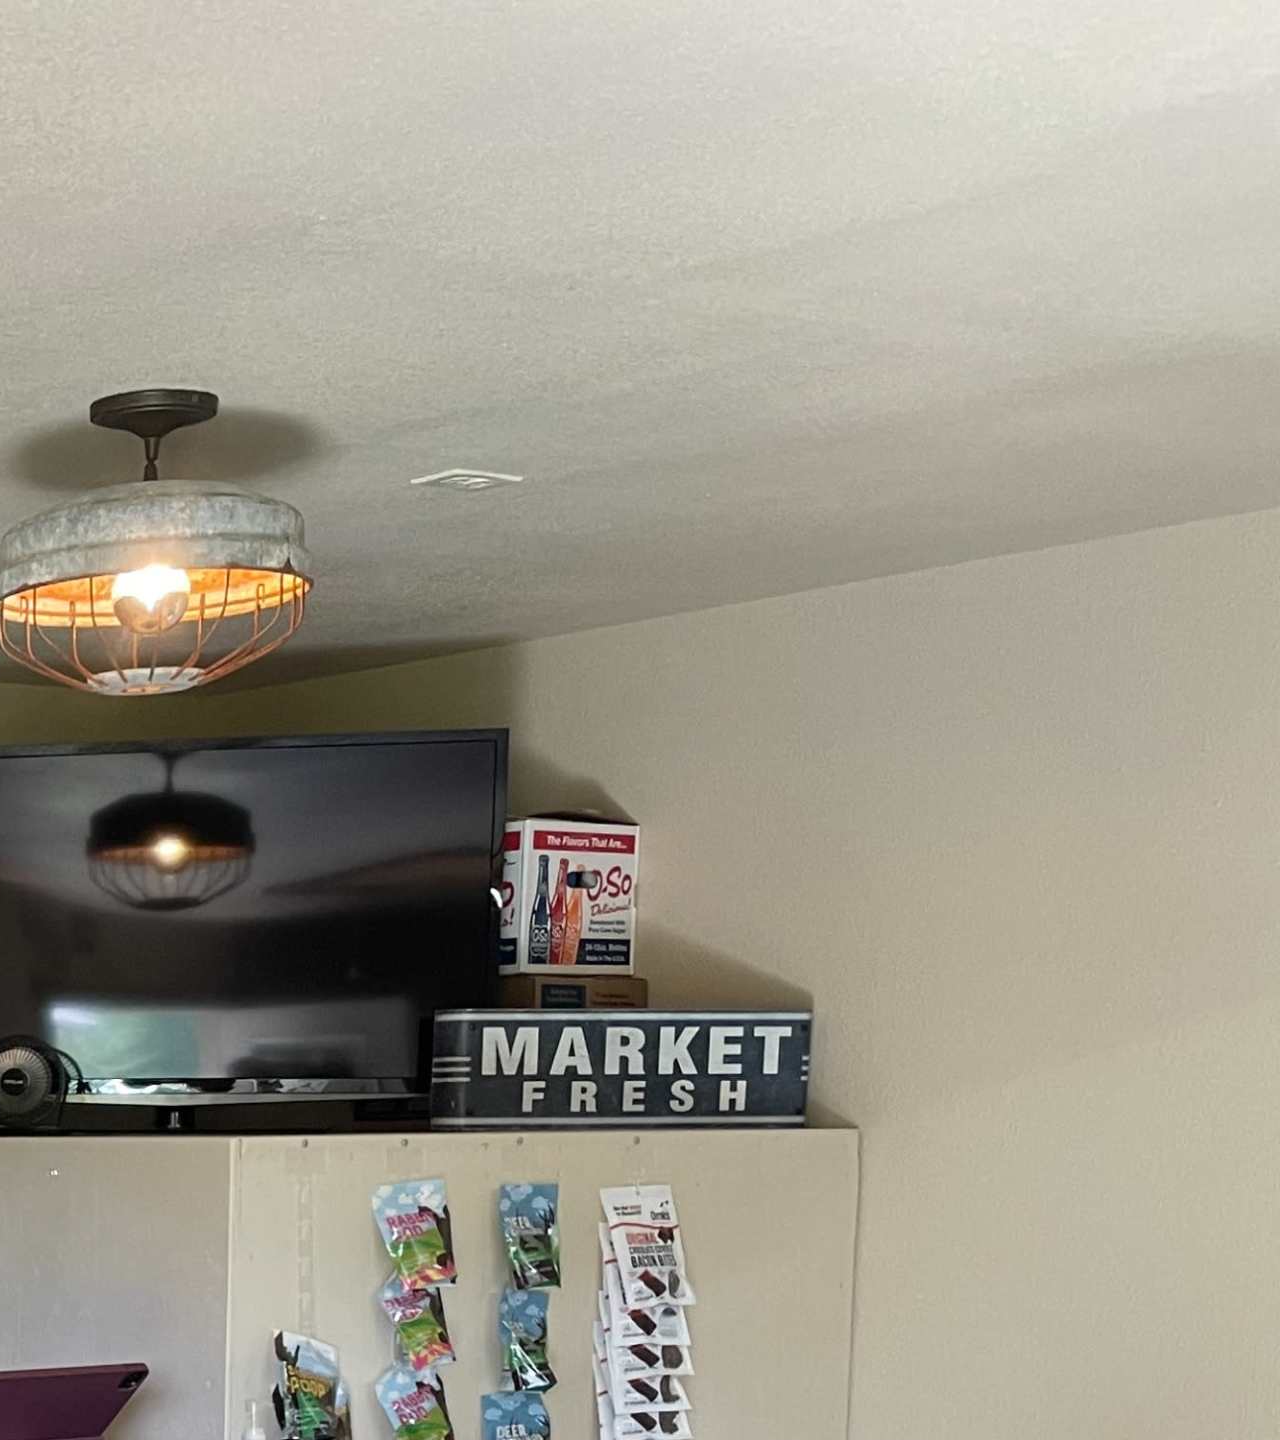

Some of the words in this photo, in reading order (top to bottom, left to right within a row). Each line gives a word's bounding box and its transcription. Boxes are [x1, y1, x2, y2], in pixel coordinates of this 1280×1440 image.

[547, 835, 561, 846] The
[562, 836, 589, 847] Flavors
[590, 837, 606, 848] That
[480, 1026, 792, 1077] MARKET
[521, 1080, 747, 1113] FRESH
[631, 1255, 658, 1268] BACON
[496, 1424, 527, 1438] DEER
